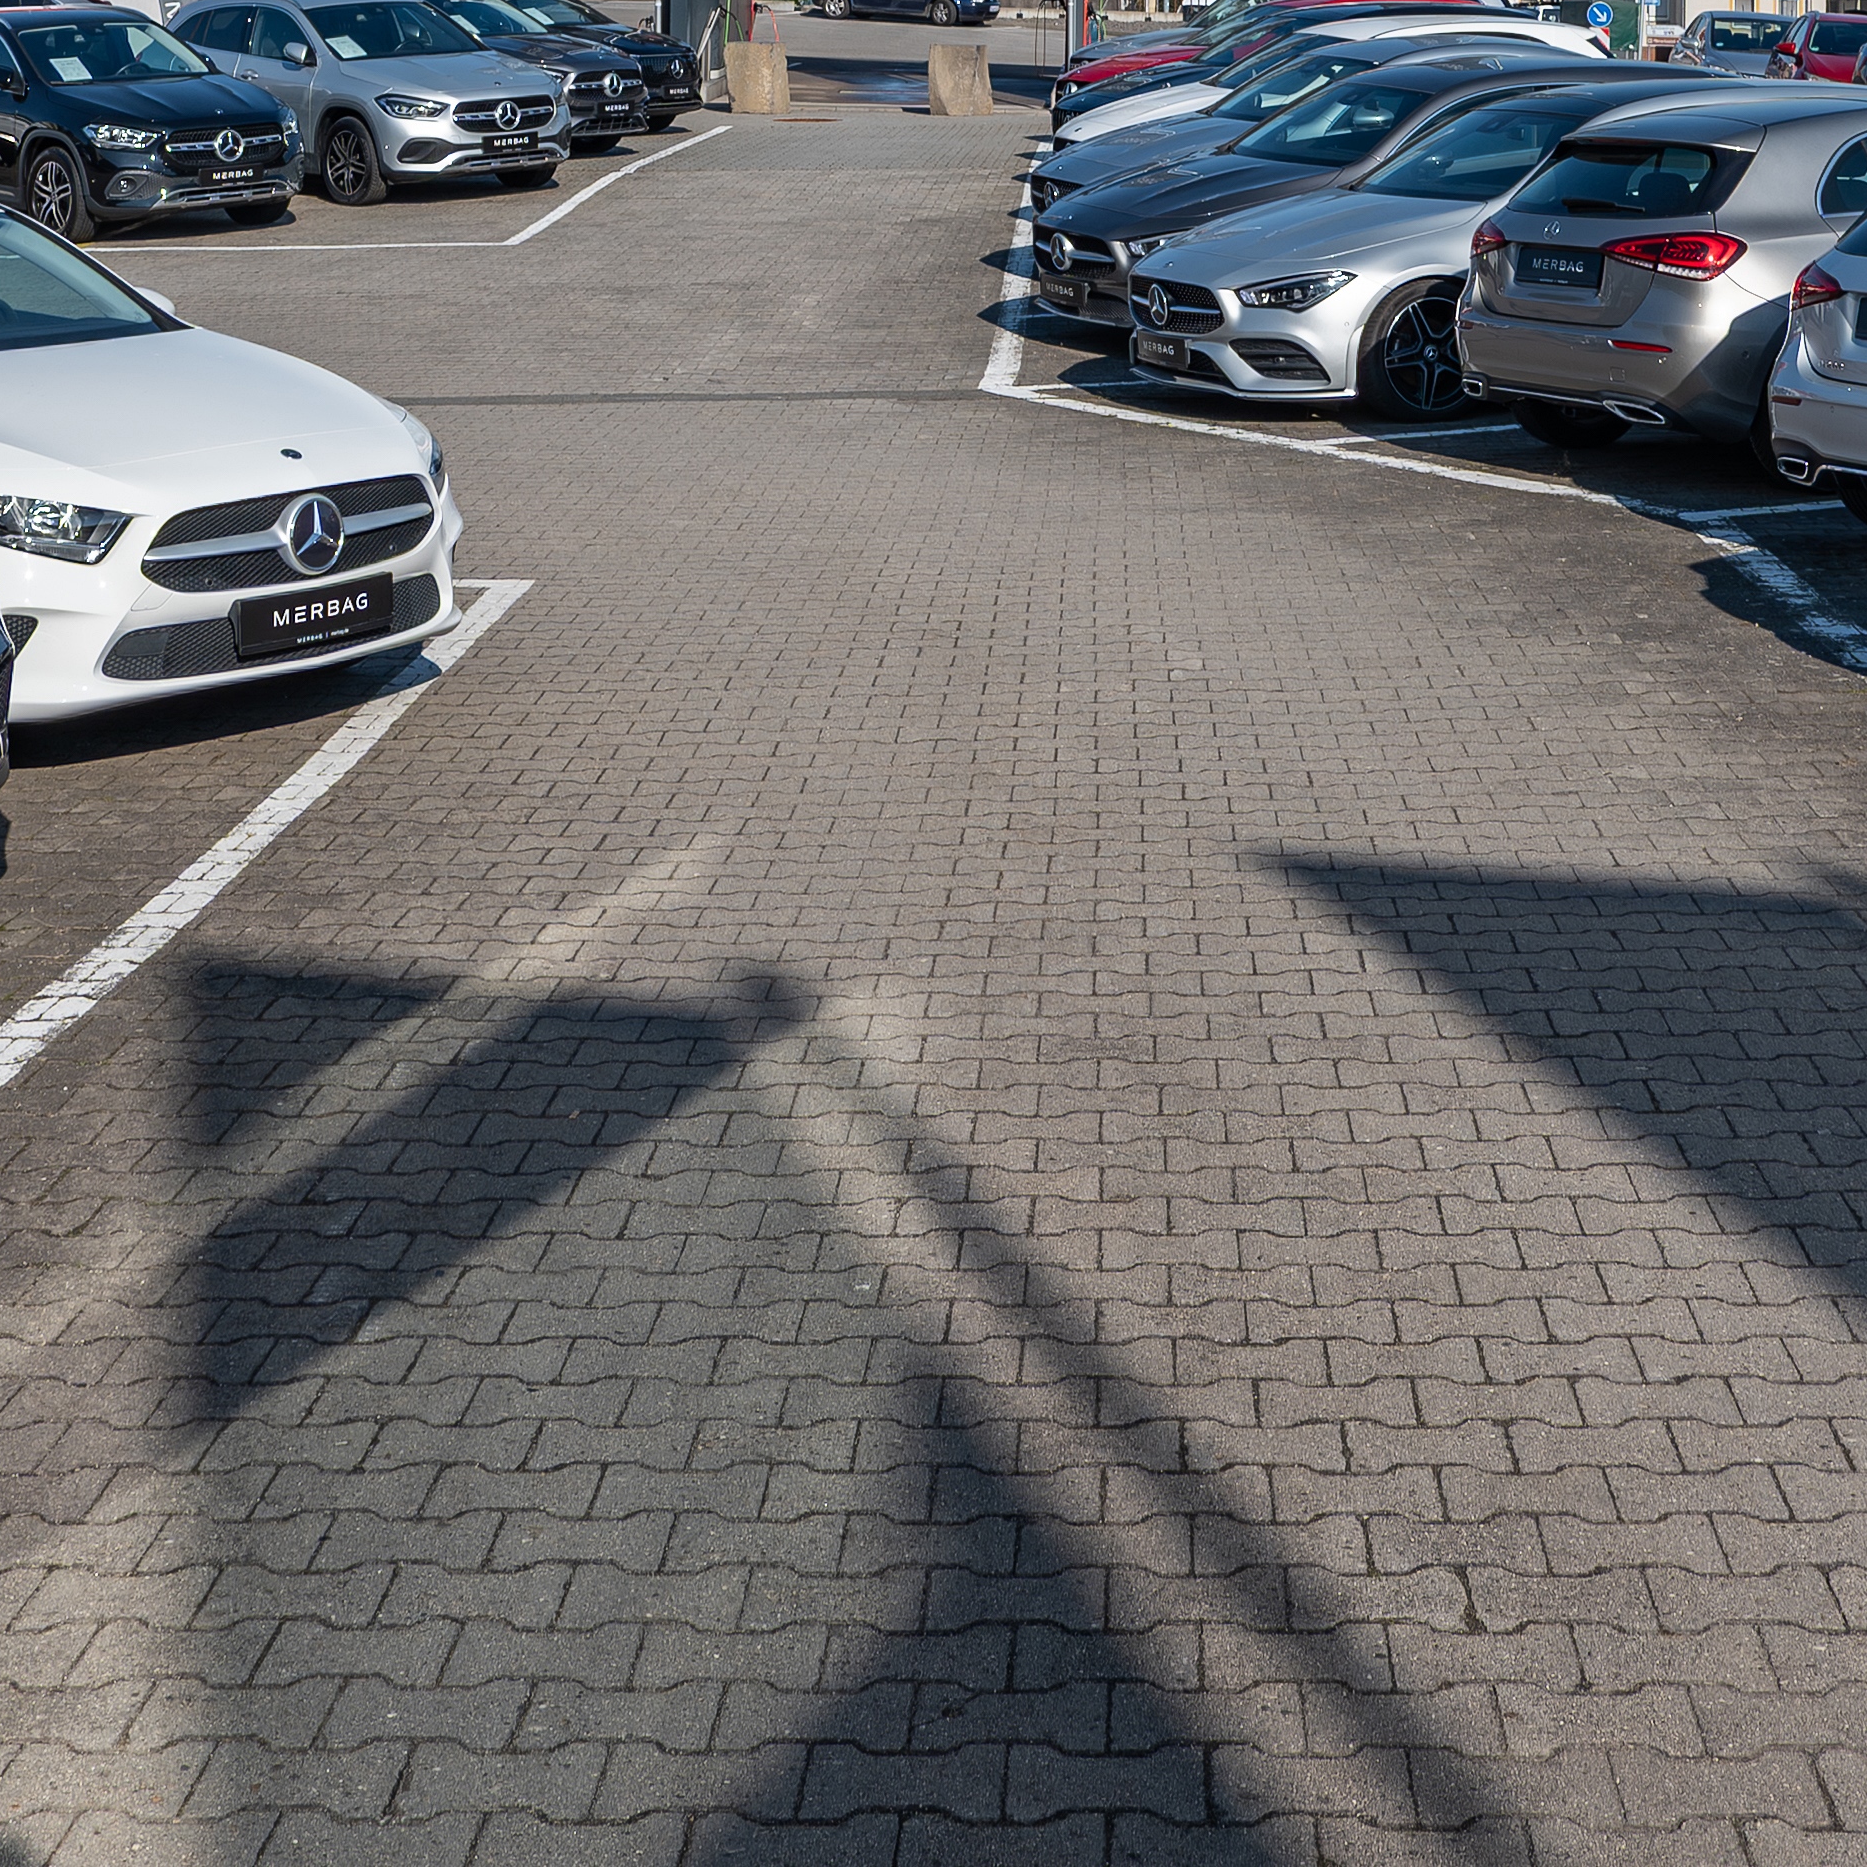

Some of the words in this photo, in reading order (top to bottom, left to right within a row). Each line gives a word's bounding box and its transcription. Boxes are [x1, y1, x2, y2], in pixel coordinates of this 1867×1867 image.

[493, 136, 529, 147] MERBAG
[212, 168, 254, 180] MERBAG
[1532, 257, 1584, 273] MERBAG
[1142, 340, 1175, 356] MERBAG
[273, 592, 369, 628] MERBAG
